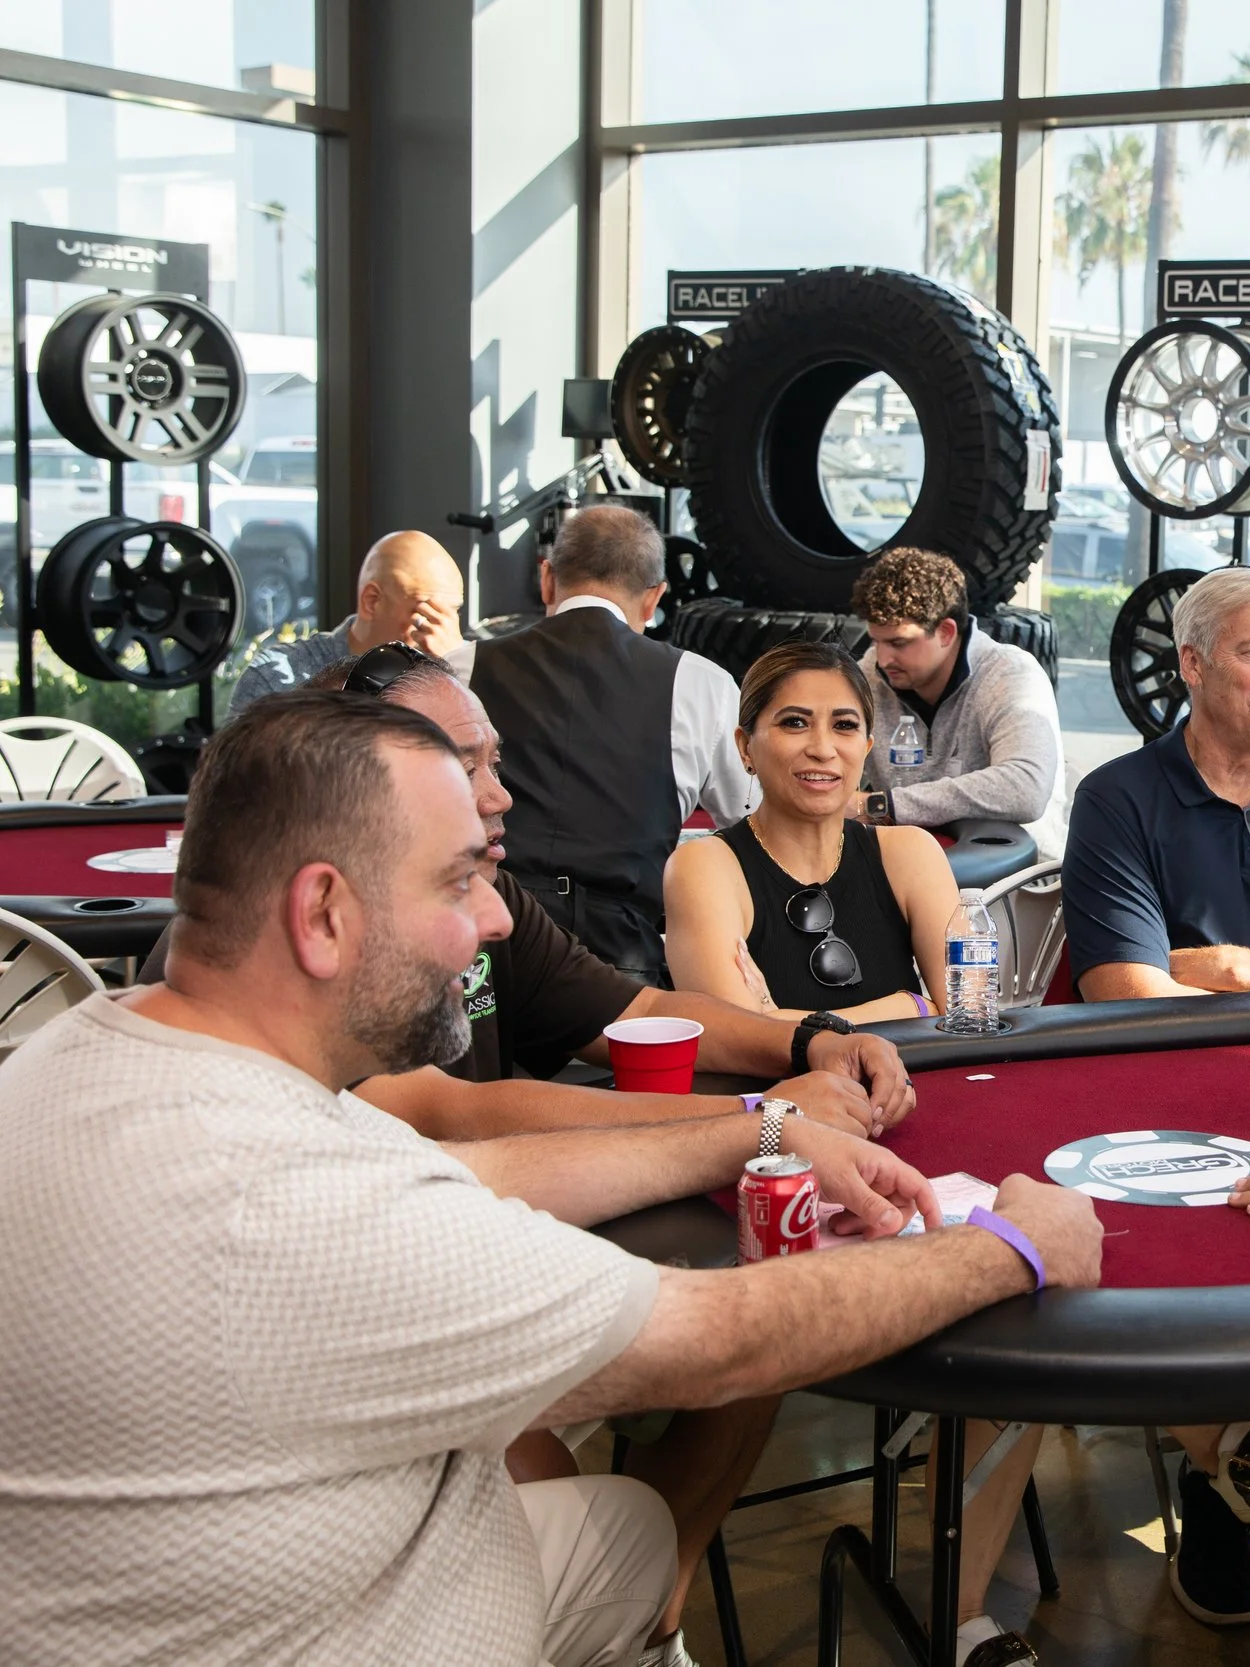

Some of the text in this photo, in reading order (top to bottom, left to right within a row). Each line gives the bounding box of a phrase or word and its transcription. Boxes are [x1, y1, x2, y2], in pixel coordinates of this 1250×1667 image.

[57, 239, 168, 265] VISION
[677, 287, 767, 309] RACELI
[1104, 1157, 1238, 1178] GRECH
